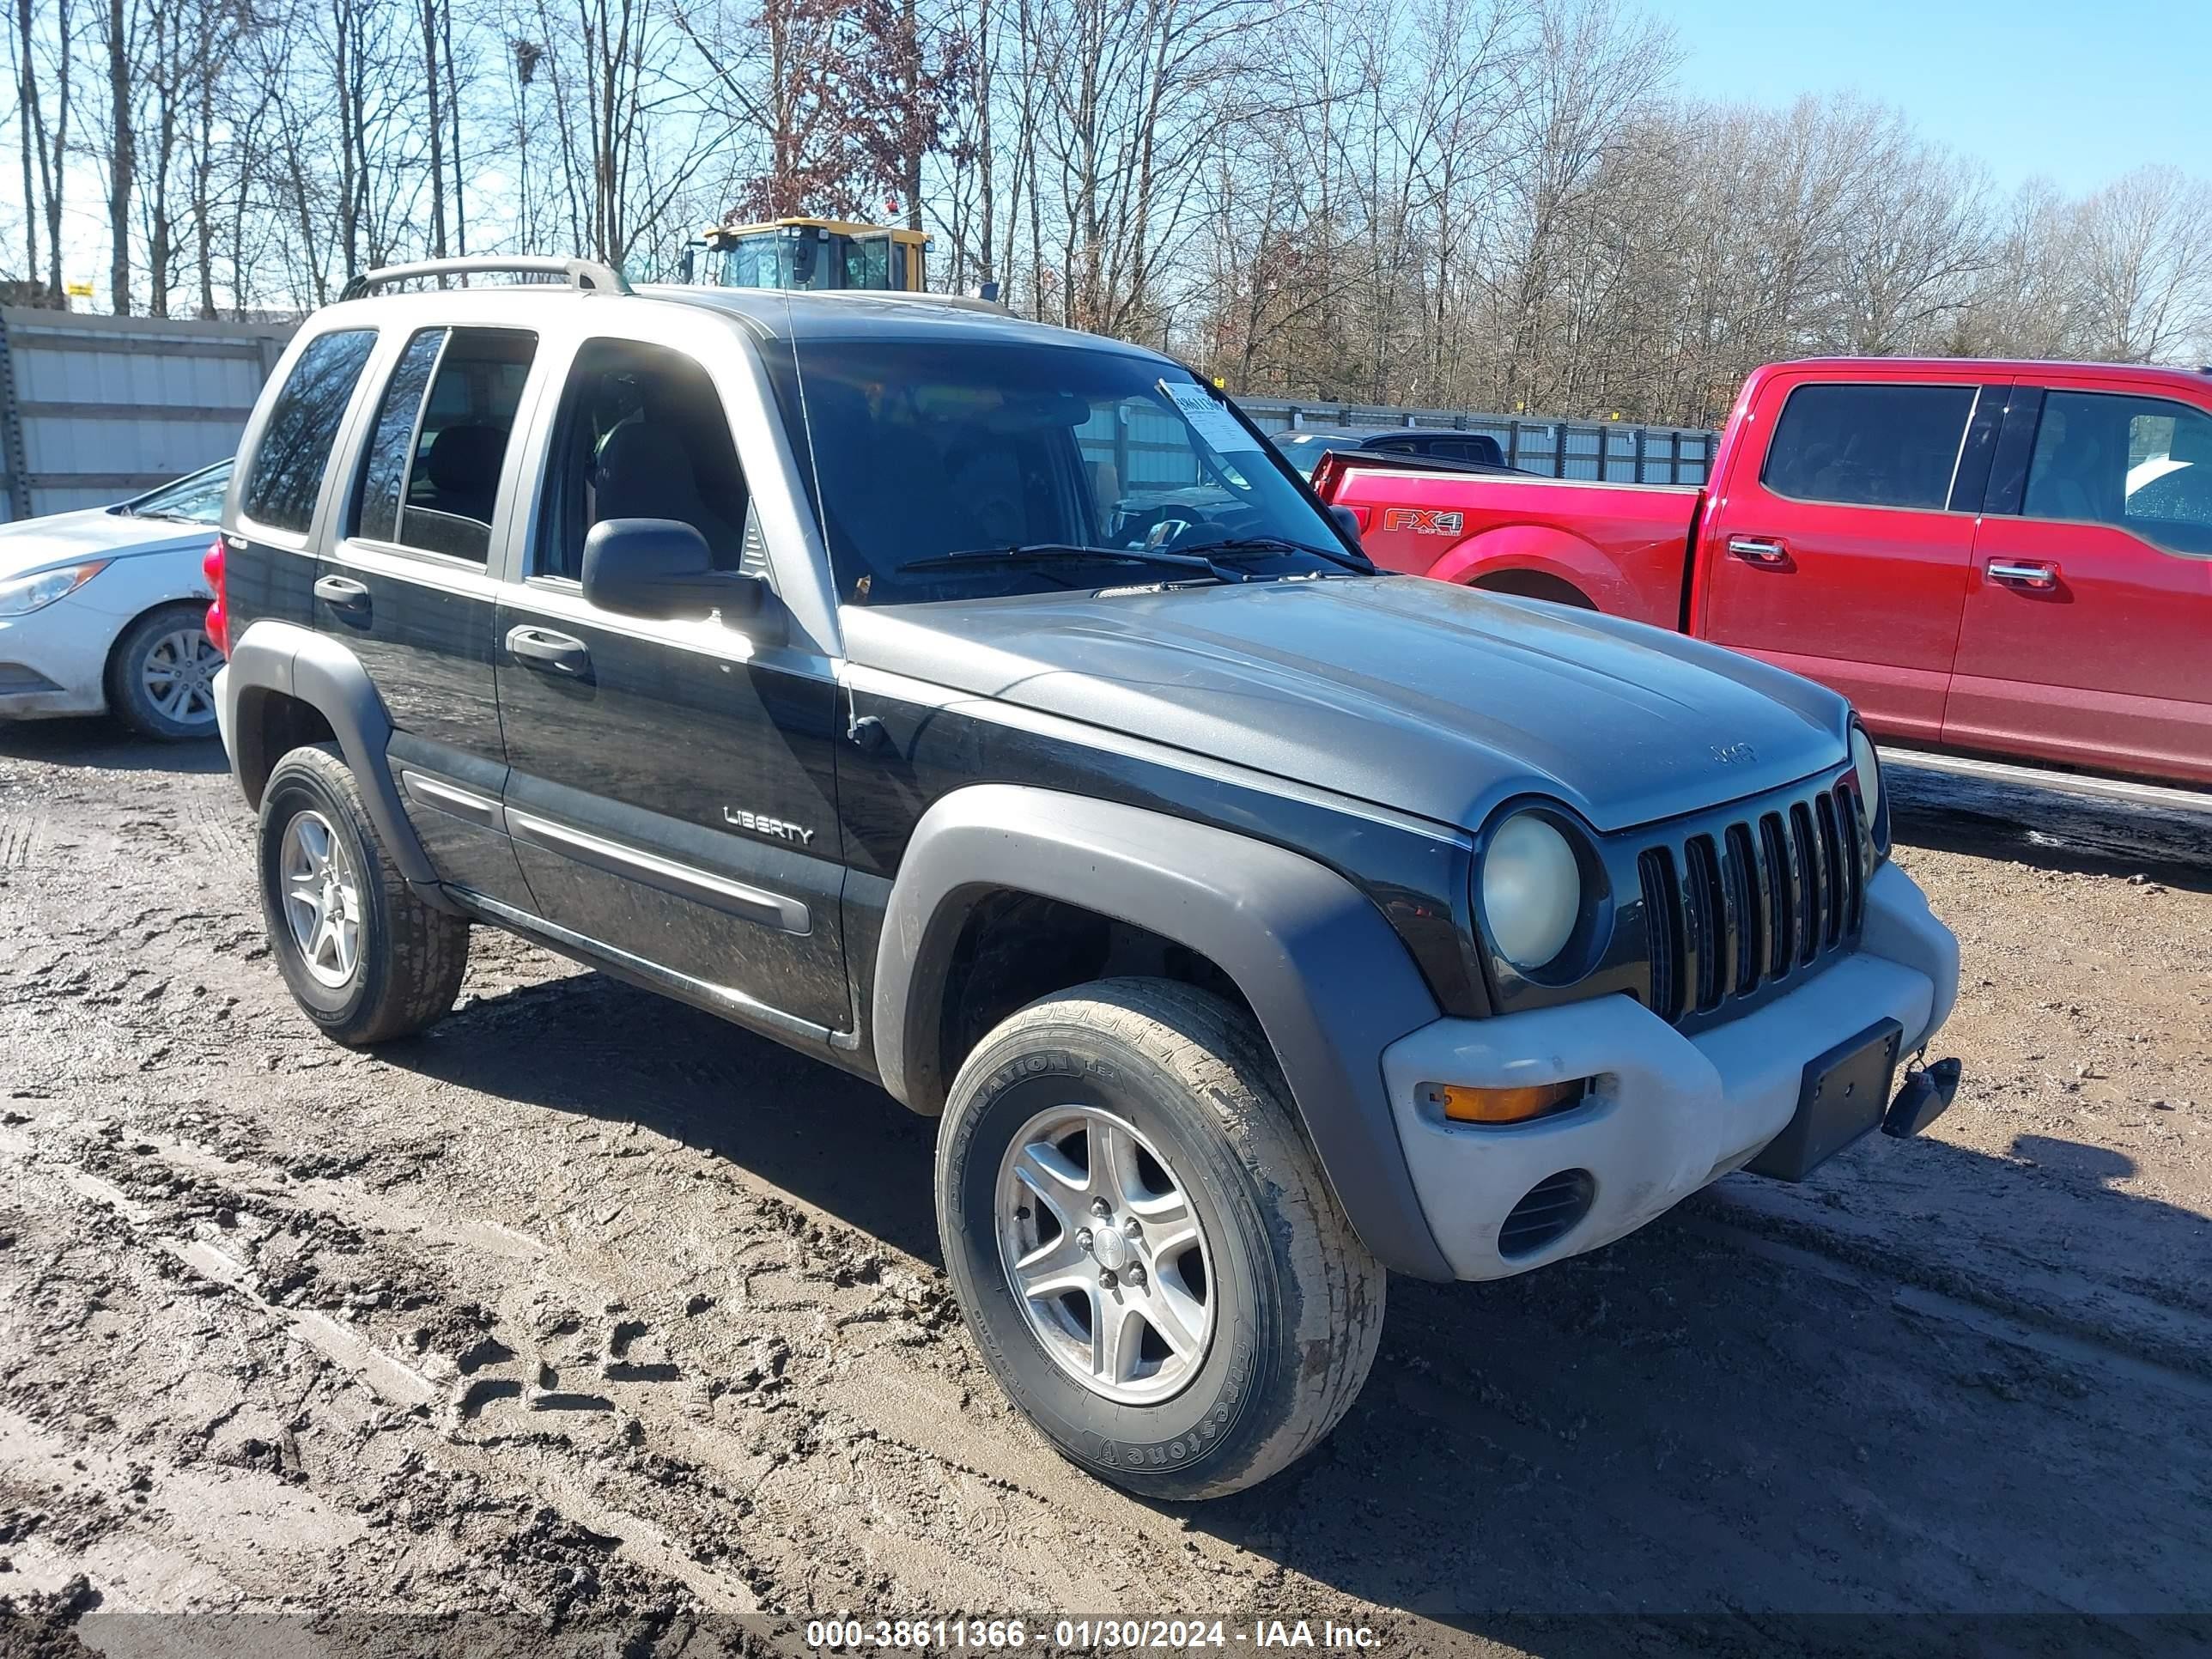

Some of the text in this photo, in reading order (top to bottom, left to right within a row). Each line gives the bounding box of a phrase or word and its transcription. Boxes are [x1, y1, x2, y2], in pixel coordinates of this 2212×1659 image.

[1176, 397, 1224, 411] 386113
[1383, 507, 1464, 532] FX4
[723, 806, 814, 845] LIBERTY
[948, 1054, 1071, 1213] DESTINATION
[1126, 1340, 1252, 1466] Firestone
